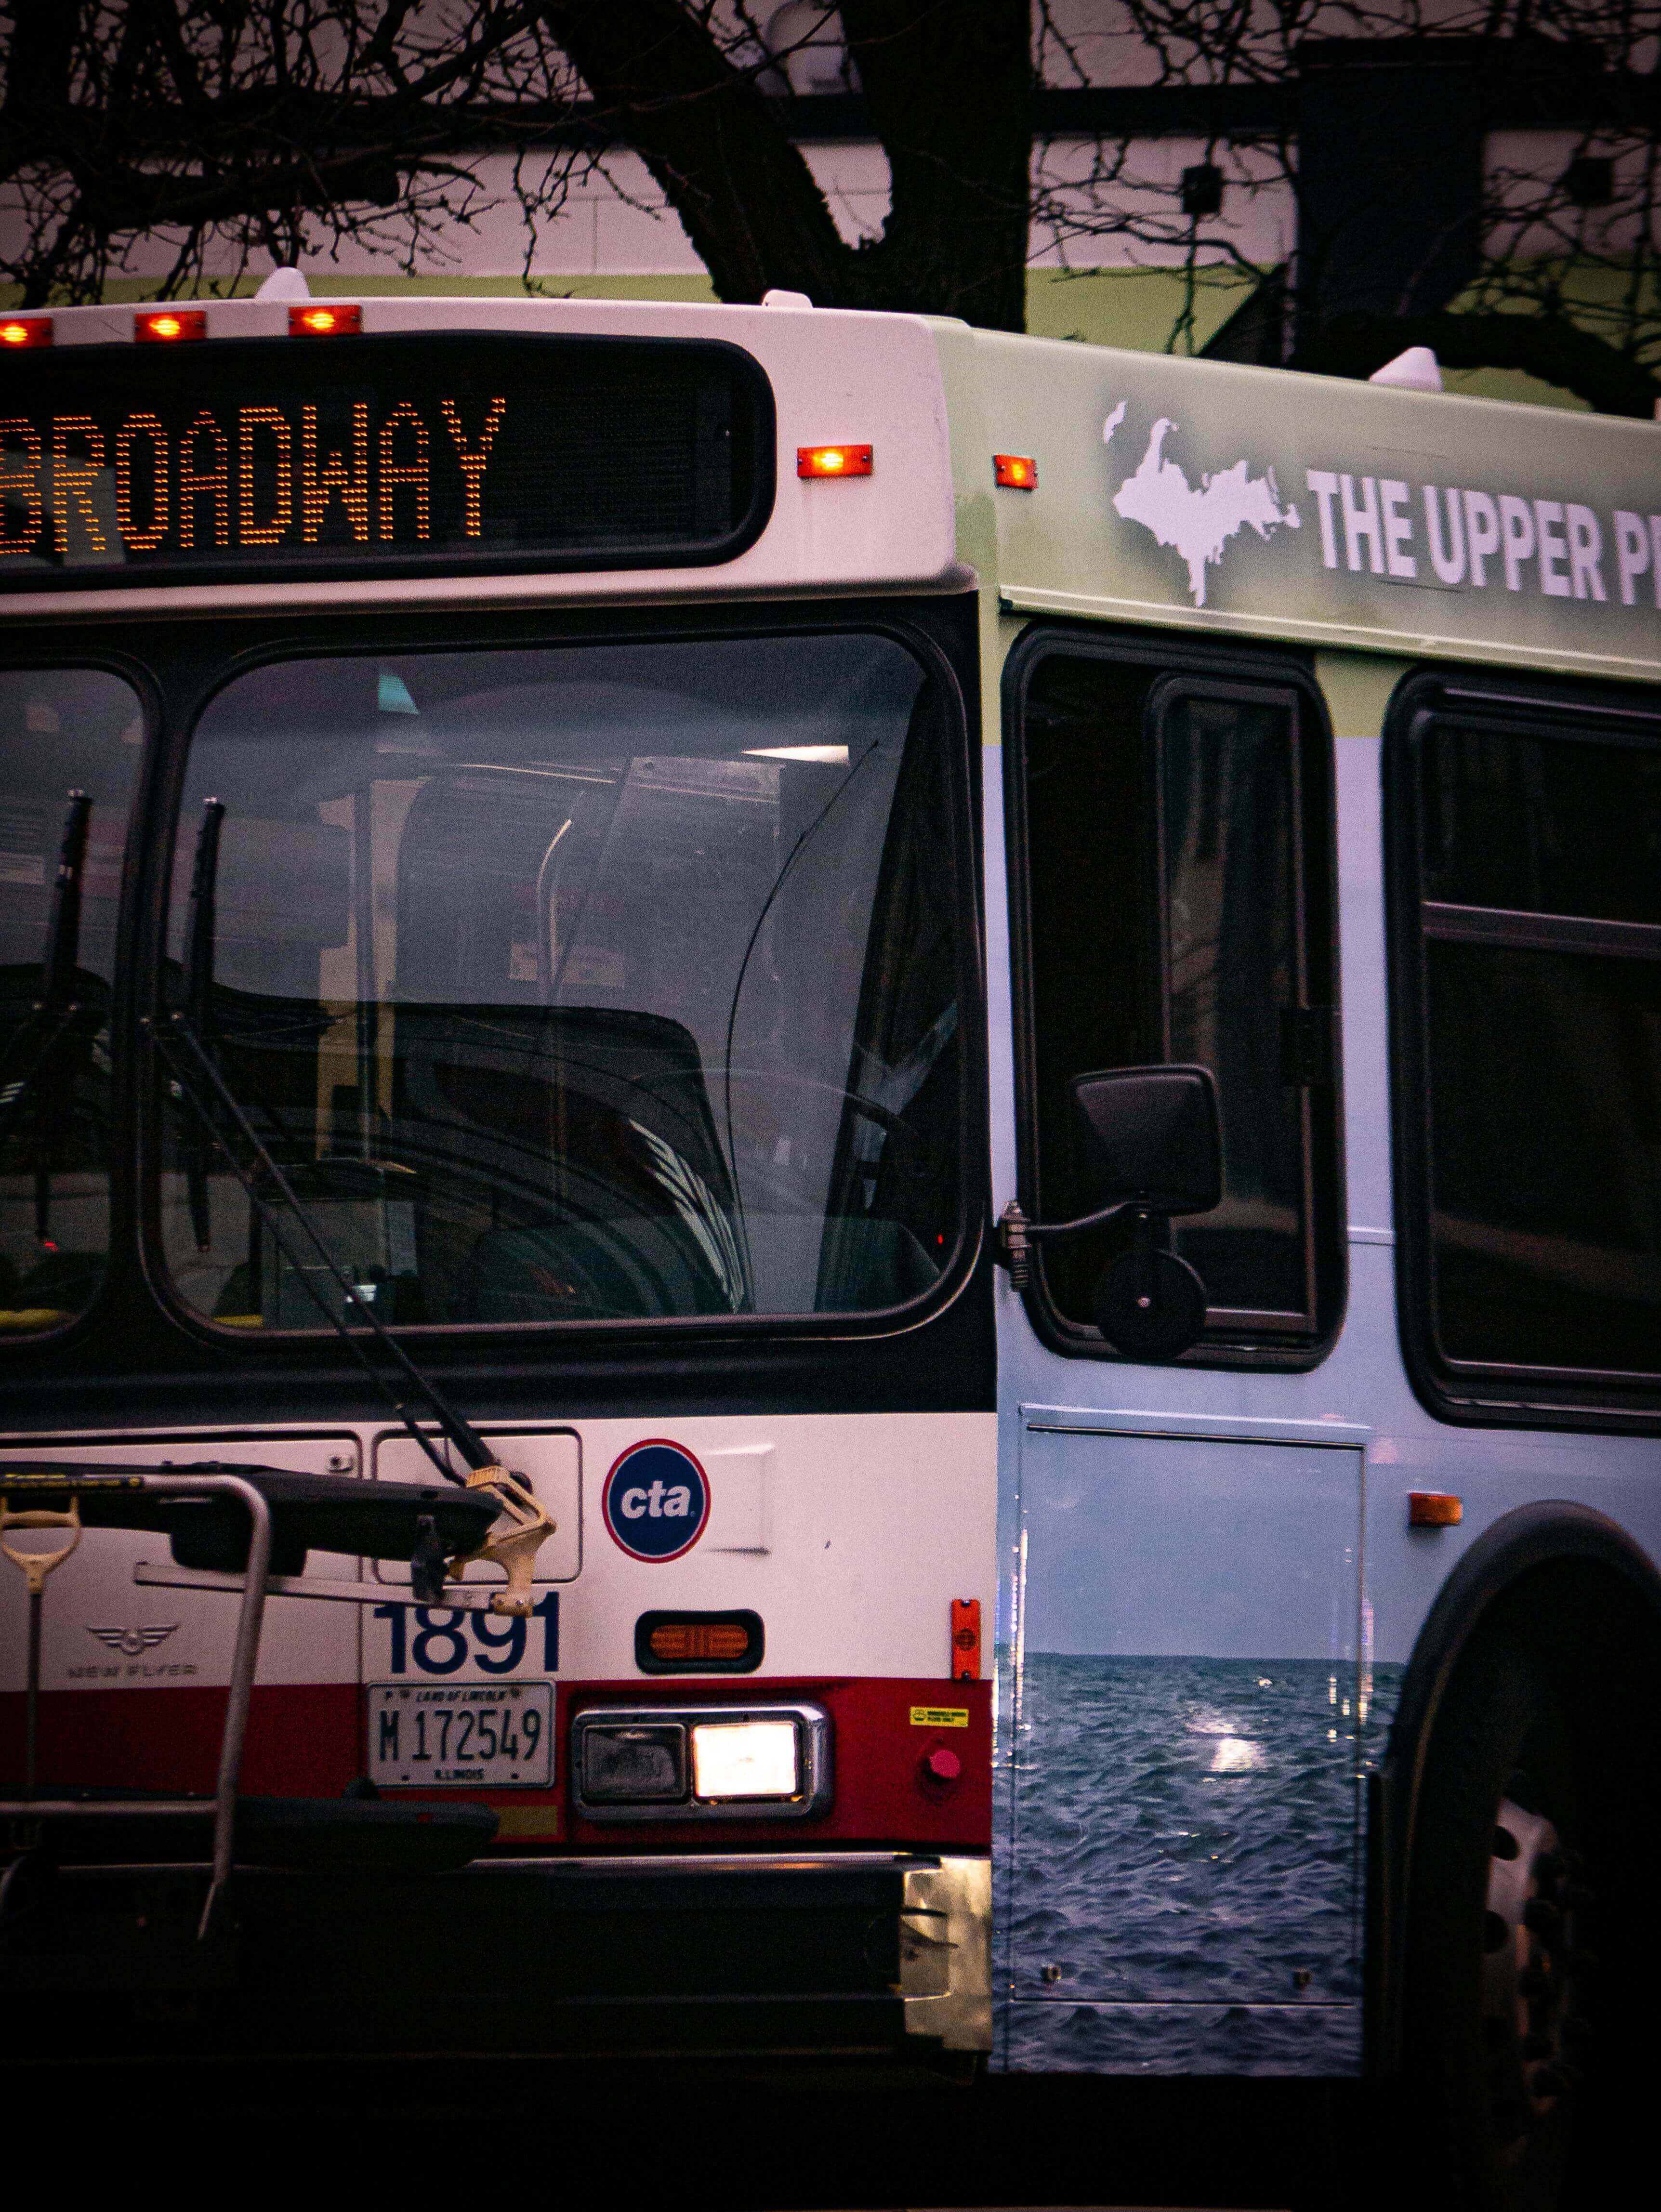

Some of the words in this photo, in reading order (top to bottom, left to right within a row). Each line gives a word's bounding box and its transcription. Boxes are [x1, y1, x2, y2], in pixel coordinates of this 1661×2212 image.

[0, 397, 505, 554] BROADWAY
[1306, 469, 1417, 578] THE
[1423, 485, 1608, 601] UPPER
[621, 1480, 691, 1519] cta
[68, 1666, 119, 1678] NEW
[128, 1664, 197, 1677] FLYER
[373, 1591, 560, 1675] 1891
